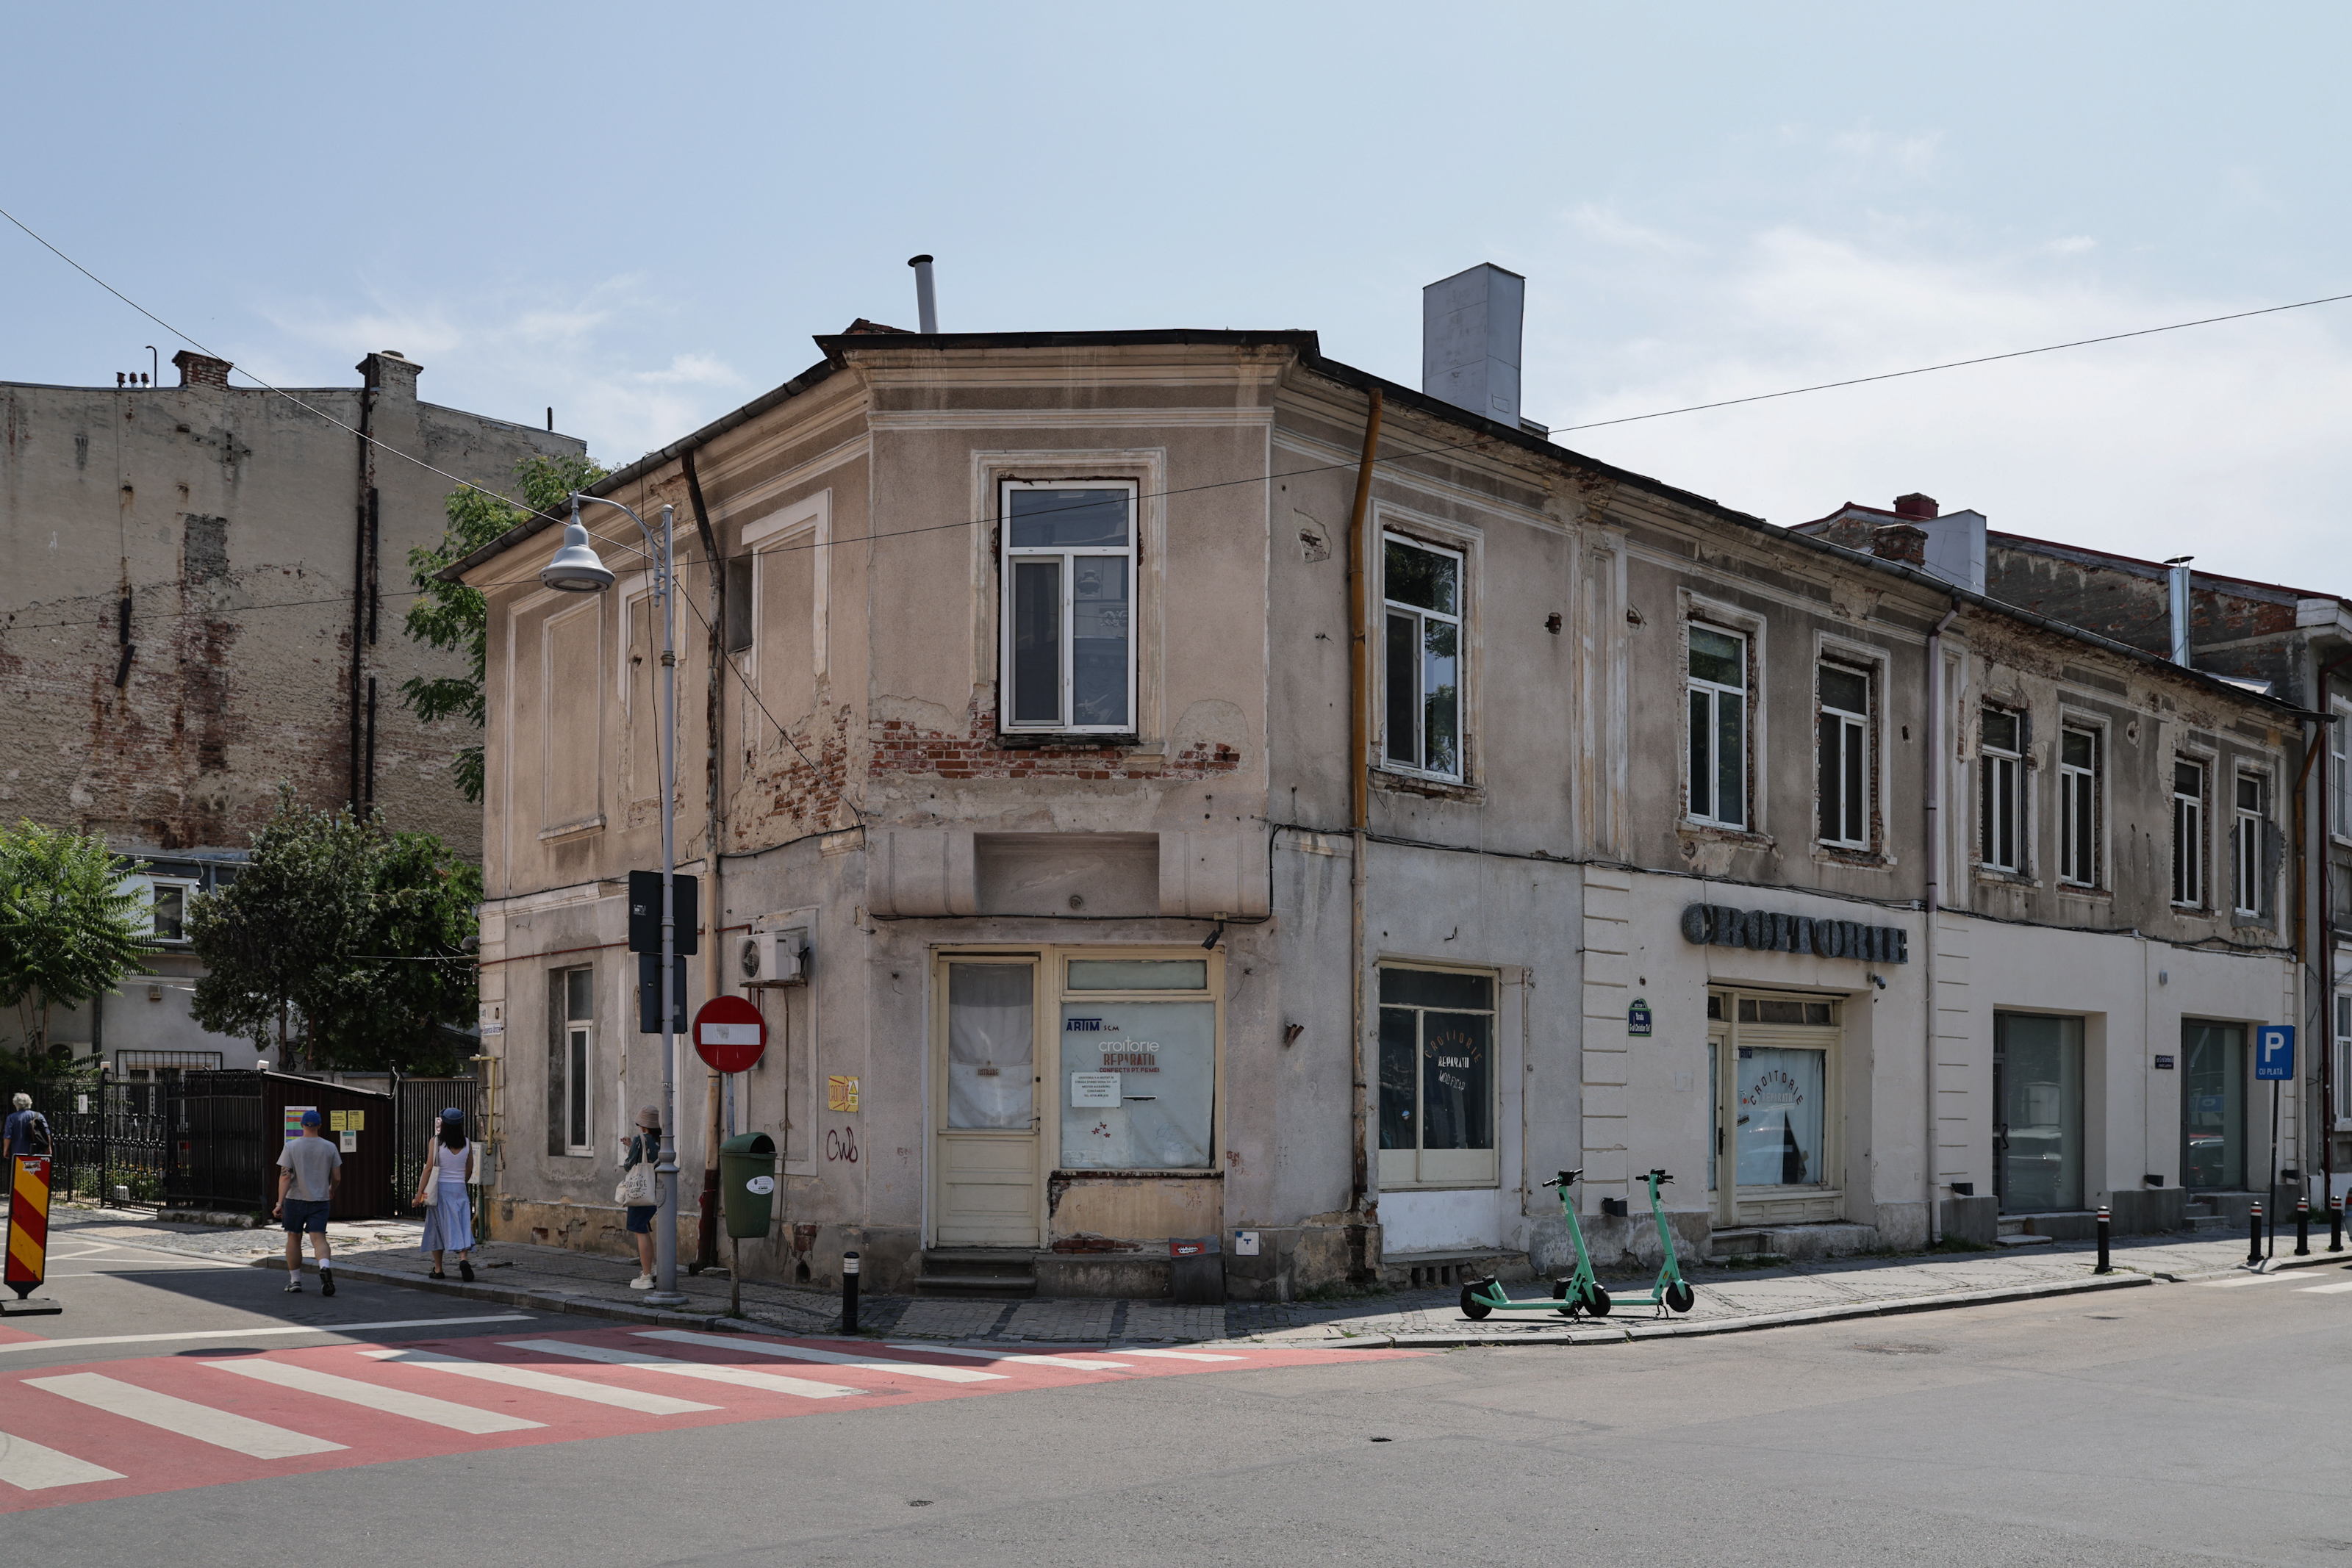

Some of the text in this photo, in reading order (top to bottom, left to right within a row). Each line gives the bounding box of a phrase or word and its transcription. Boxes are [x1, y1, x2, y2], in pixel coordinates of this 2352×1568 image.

[1682, 902, 1909, 964] CROITORIE
[1066, 1018, 1102, 1031] ARTIM
[1098, 1035, 1159, 1052] croitorie
[2265, 1032, 2284, 1062] P
[2259, 1068, 2266, 1076] CU
[1750, 1070, 1804, 1106] CROITORIE
[625, 1179, 648, 1189] ORANGE
